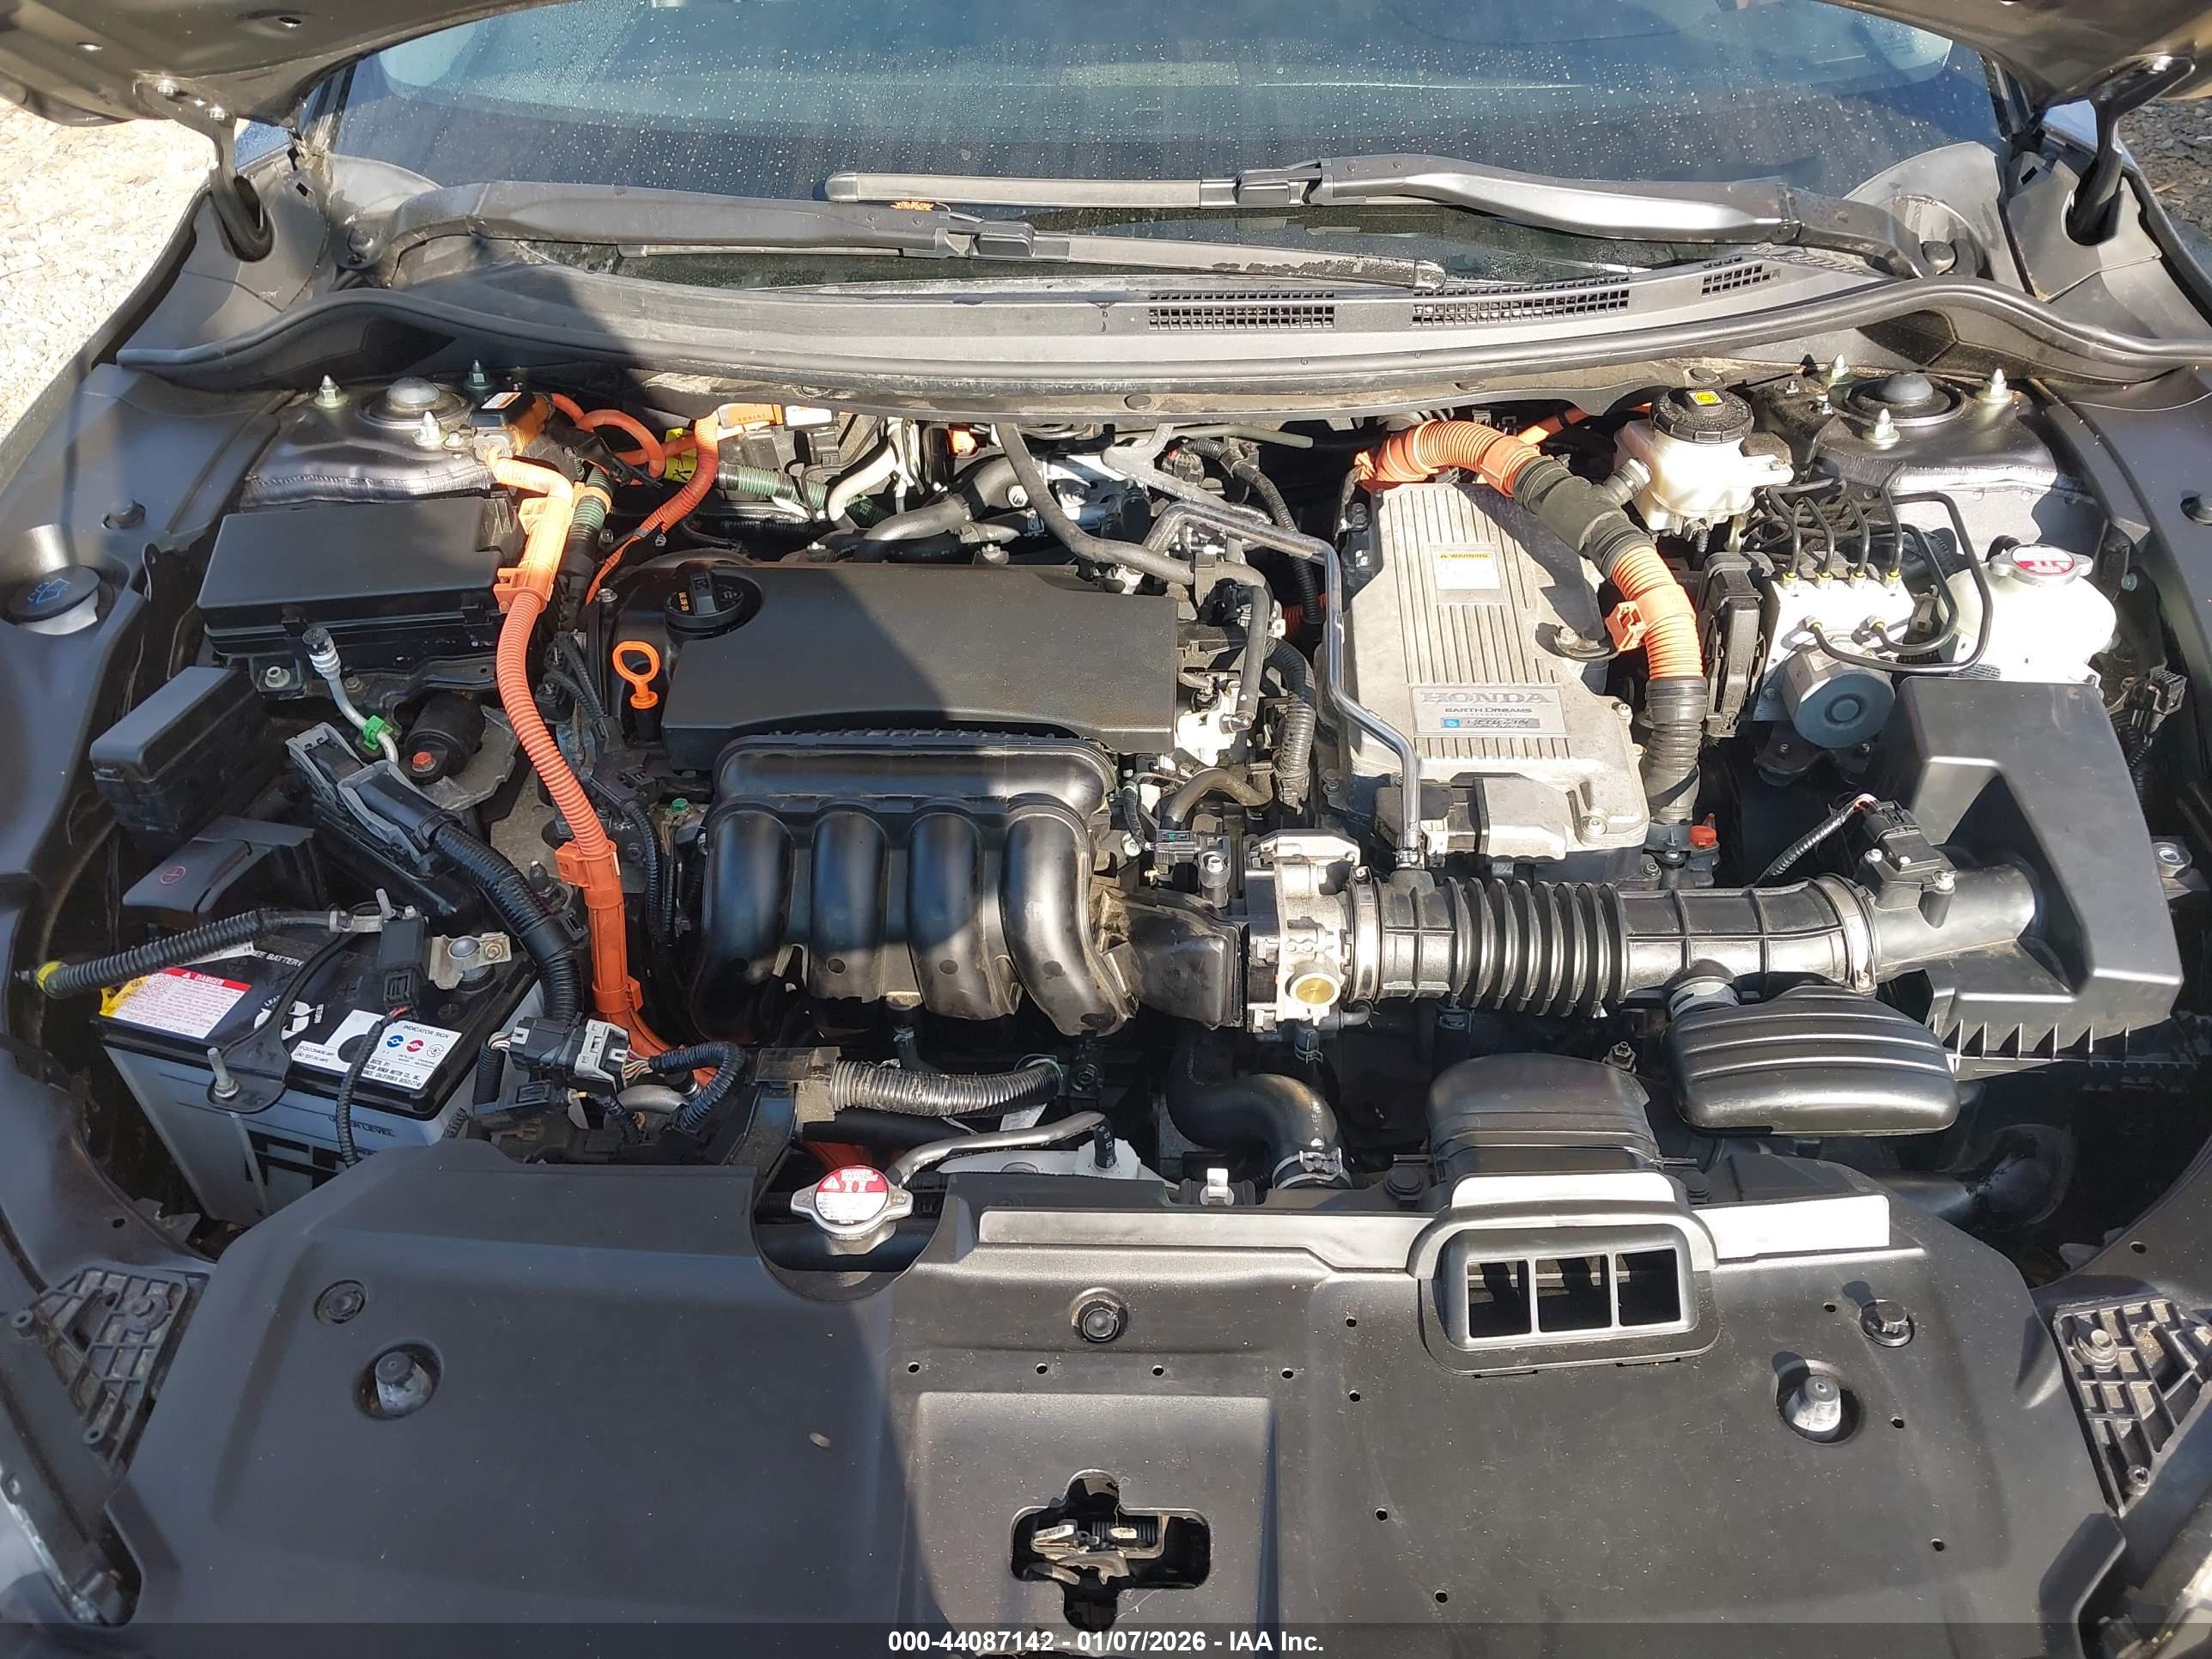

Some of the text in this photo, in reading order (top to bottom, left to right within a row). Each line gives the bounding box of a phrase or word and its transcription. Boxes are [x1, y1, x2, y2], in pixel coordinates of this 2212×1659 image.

[1421, 691, 1553, 703] HONDA
[266, 953, 304, 967] BATTERY
[194, 974, 225, 986] DANGER
[404, 1024, 434, 1036] INDICATOR
